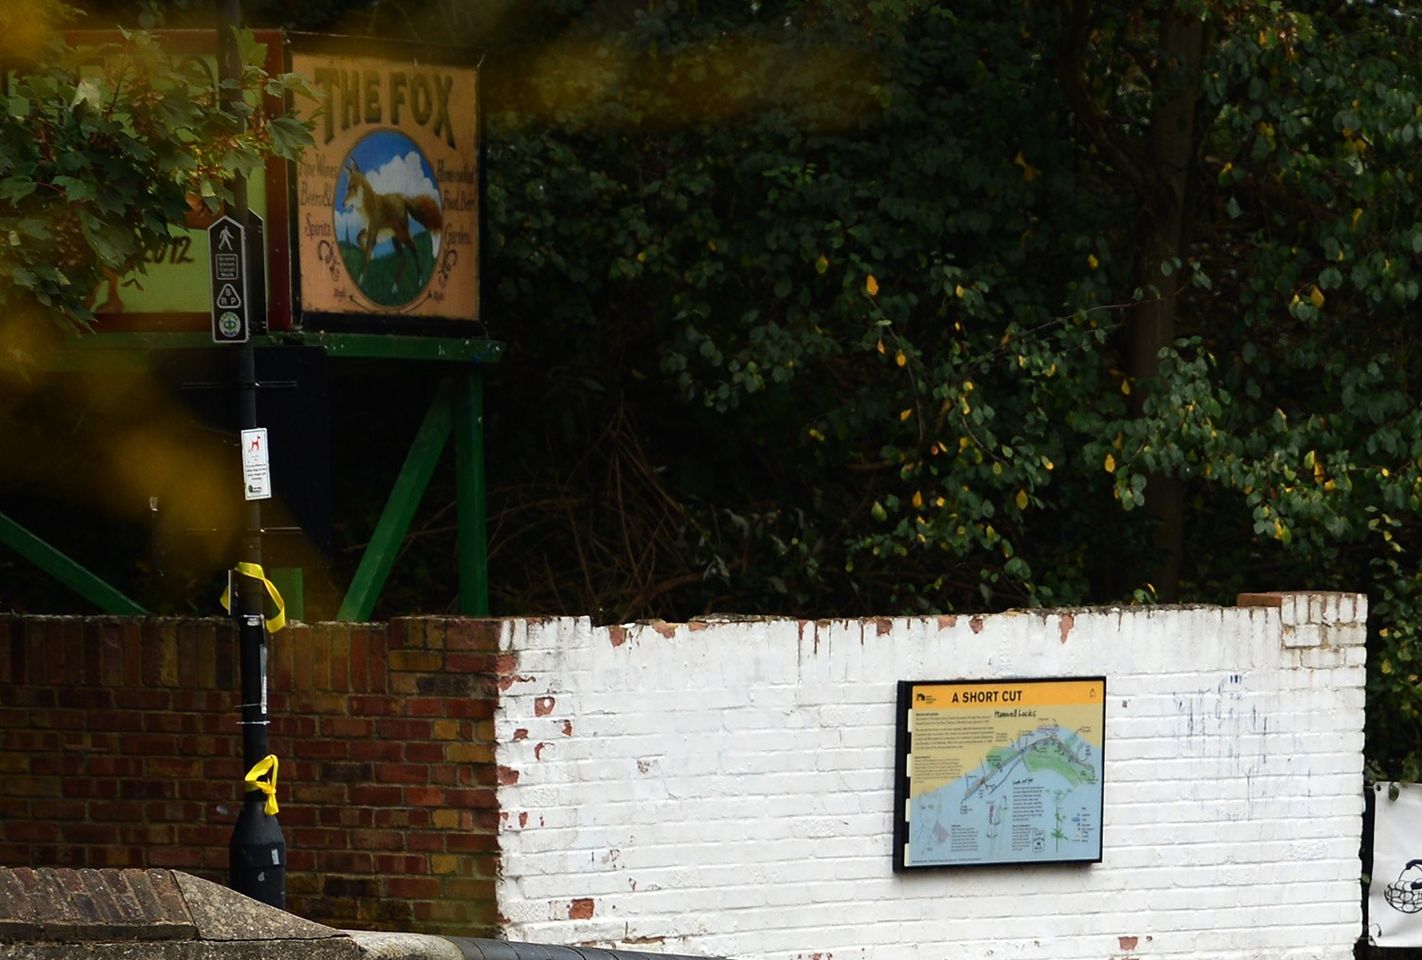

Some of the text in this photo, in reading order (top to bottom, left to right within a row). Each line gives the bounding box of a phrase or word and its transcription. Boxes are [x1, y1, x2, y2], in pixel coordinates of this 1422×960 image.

[314, 67, 456, 149] THE FOX
[951, 692, 959, 703] A
[962, 690, 999, 703] SHORT
[1001, 690, 1023, 702] CUT
